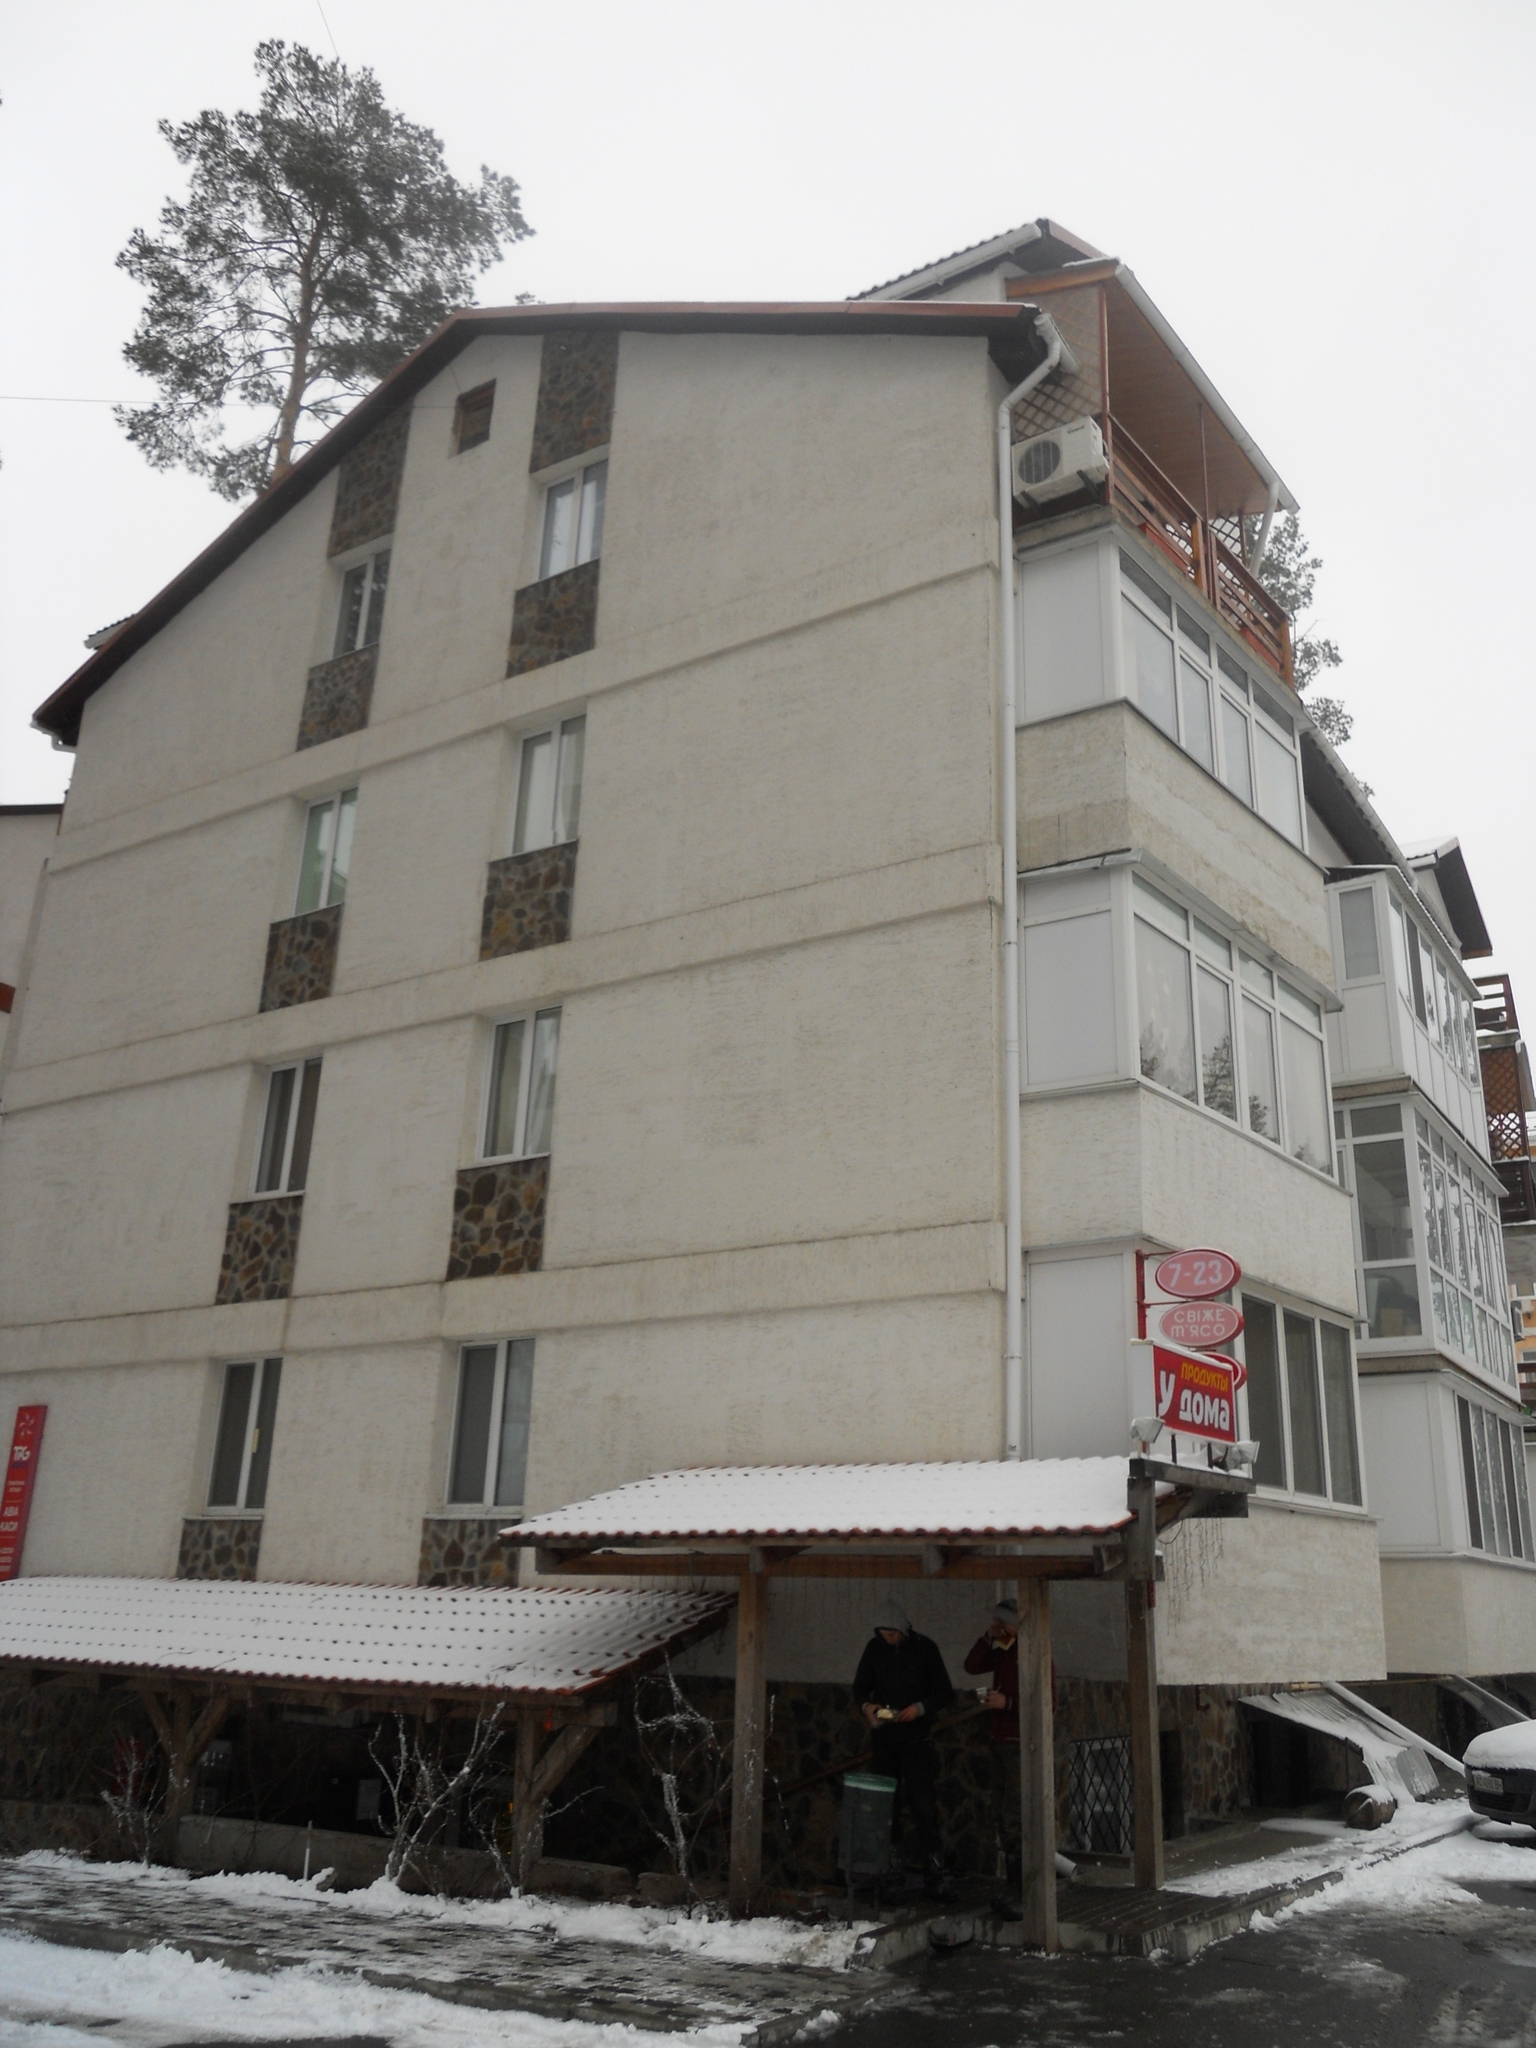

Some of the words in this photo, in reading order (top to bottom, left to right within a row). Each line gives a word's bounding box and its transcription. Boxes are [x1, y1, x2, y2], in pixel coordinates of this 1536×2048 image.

[1168, 1260, 1222, 1288] 7-23
[1174, 1308, 1225, 1323] СВІЖЕ
[1181, 1362, 1229, 1392] ПРОДУКТЫ
